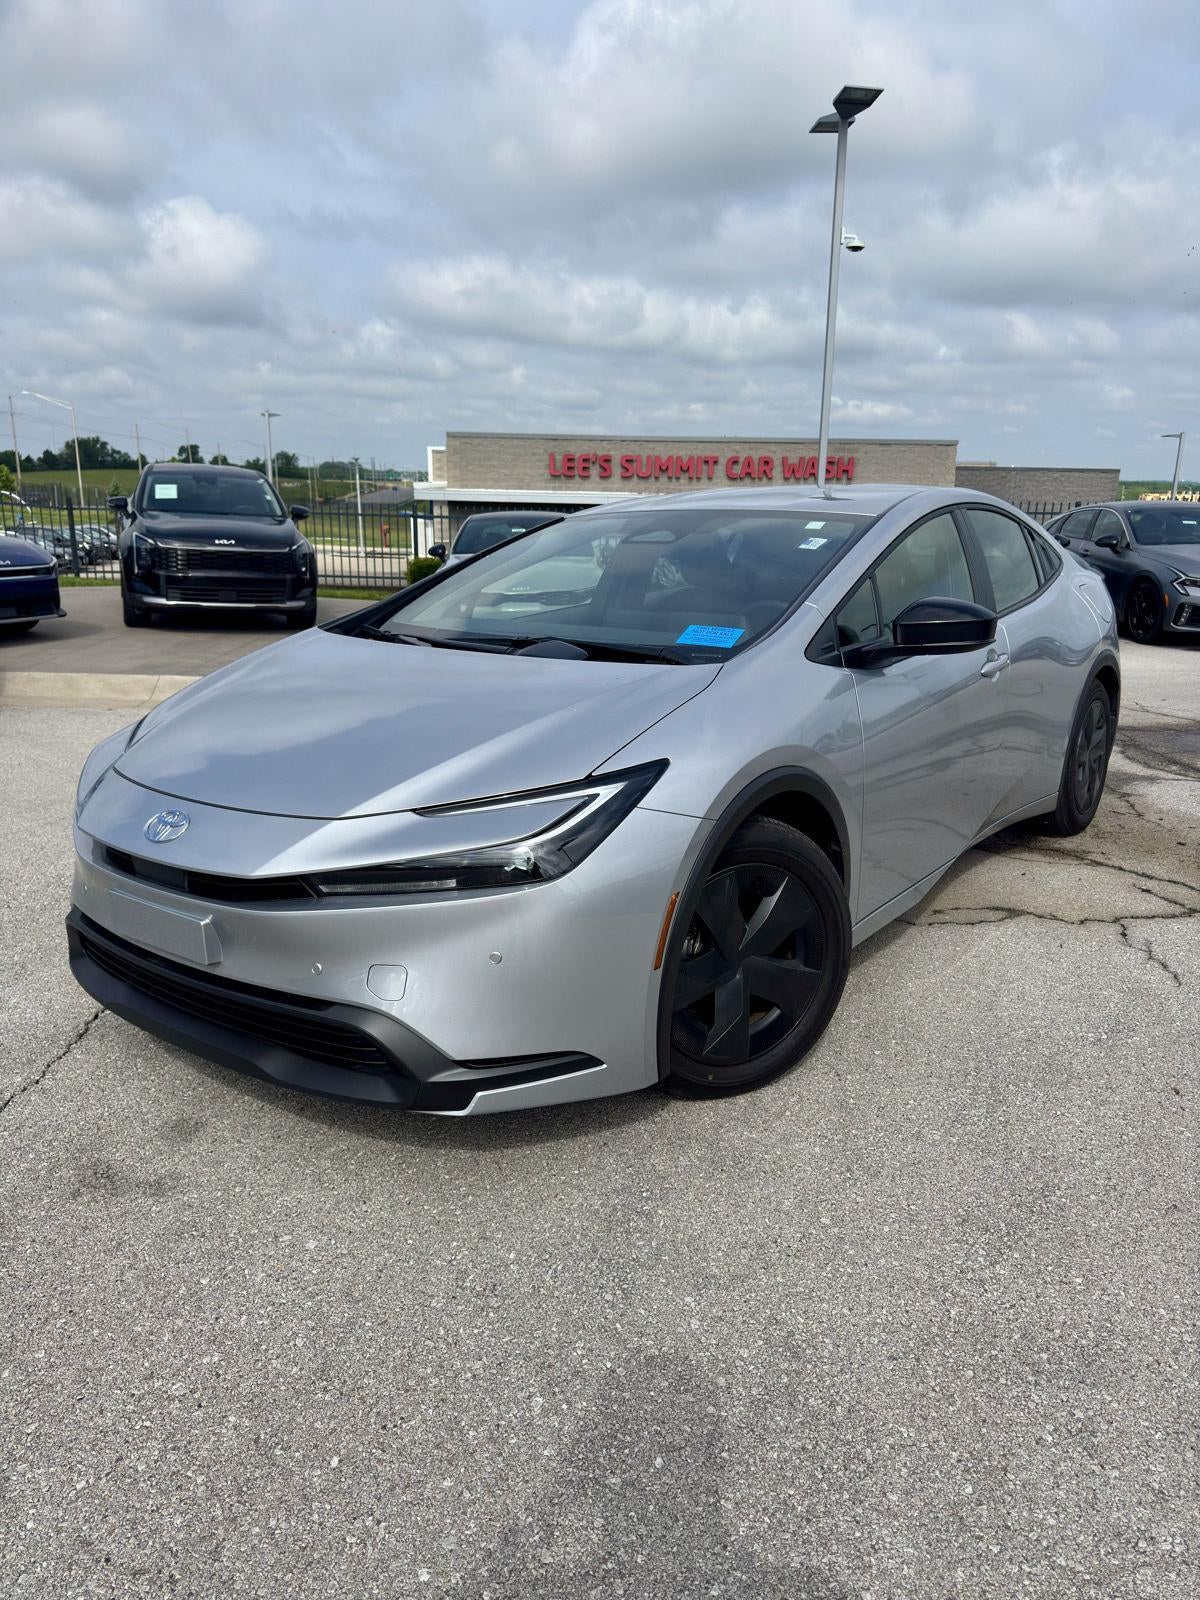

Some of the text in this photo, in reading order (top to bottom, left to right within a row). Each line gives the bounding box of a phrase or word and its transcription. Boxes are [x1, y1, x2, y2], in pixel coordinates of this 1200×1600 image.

[548, 452, 856, 481] LEE'S SUMMIT CAR WASH
